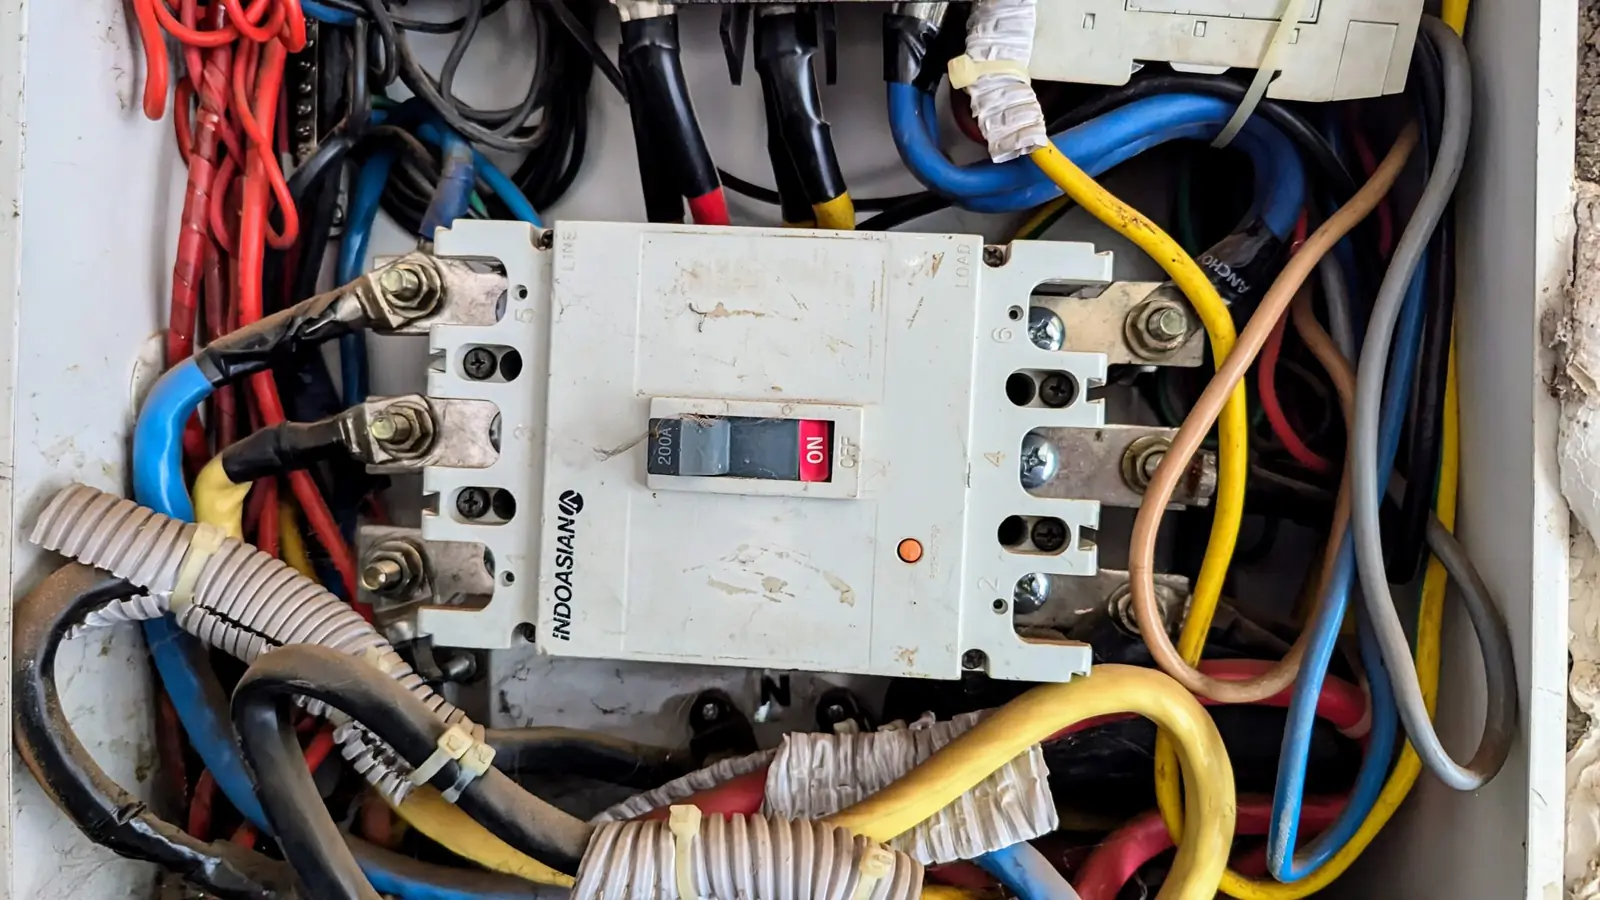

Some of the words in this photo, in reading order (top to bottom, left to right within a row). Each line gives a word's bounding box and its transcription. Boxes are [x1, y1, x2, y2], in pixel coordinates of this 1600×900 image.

[561, 230, 577, 272] LINE
[955, 243, 971, 290] LOAD
[514, 308, 535, 323] 5
[990, 327, 1013, 344] 6
[658, 427, 673, 466] 200A
[806, 436, 824, 464] ON
[839, 435, 857, 469] OFF
[984, 450, 1004, 468] 4
[978, 577, 999, 592] 2
[760, 674, 791, 708] N
